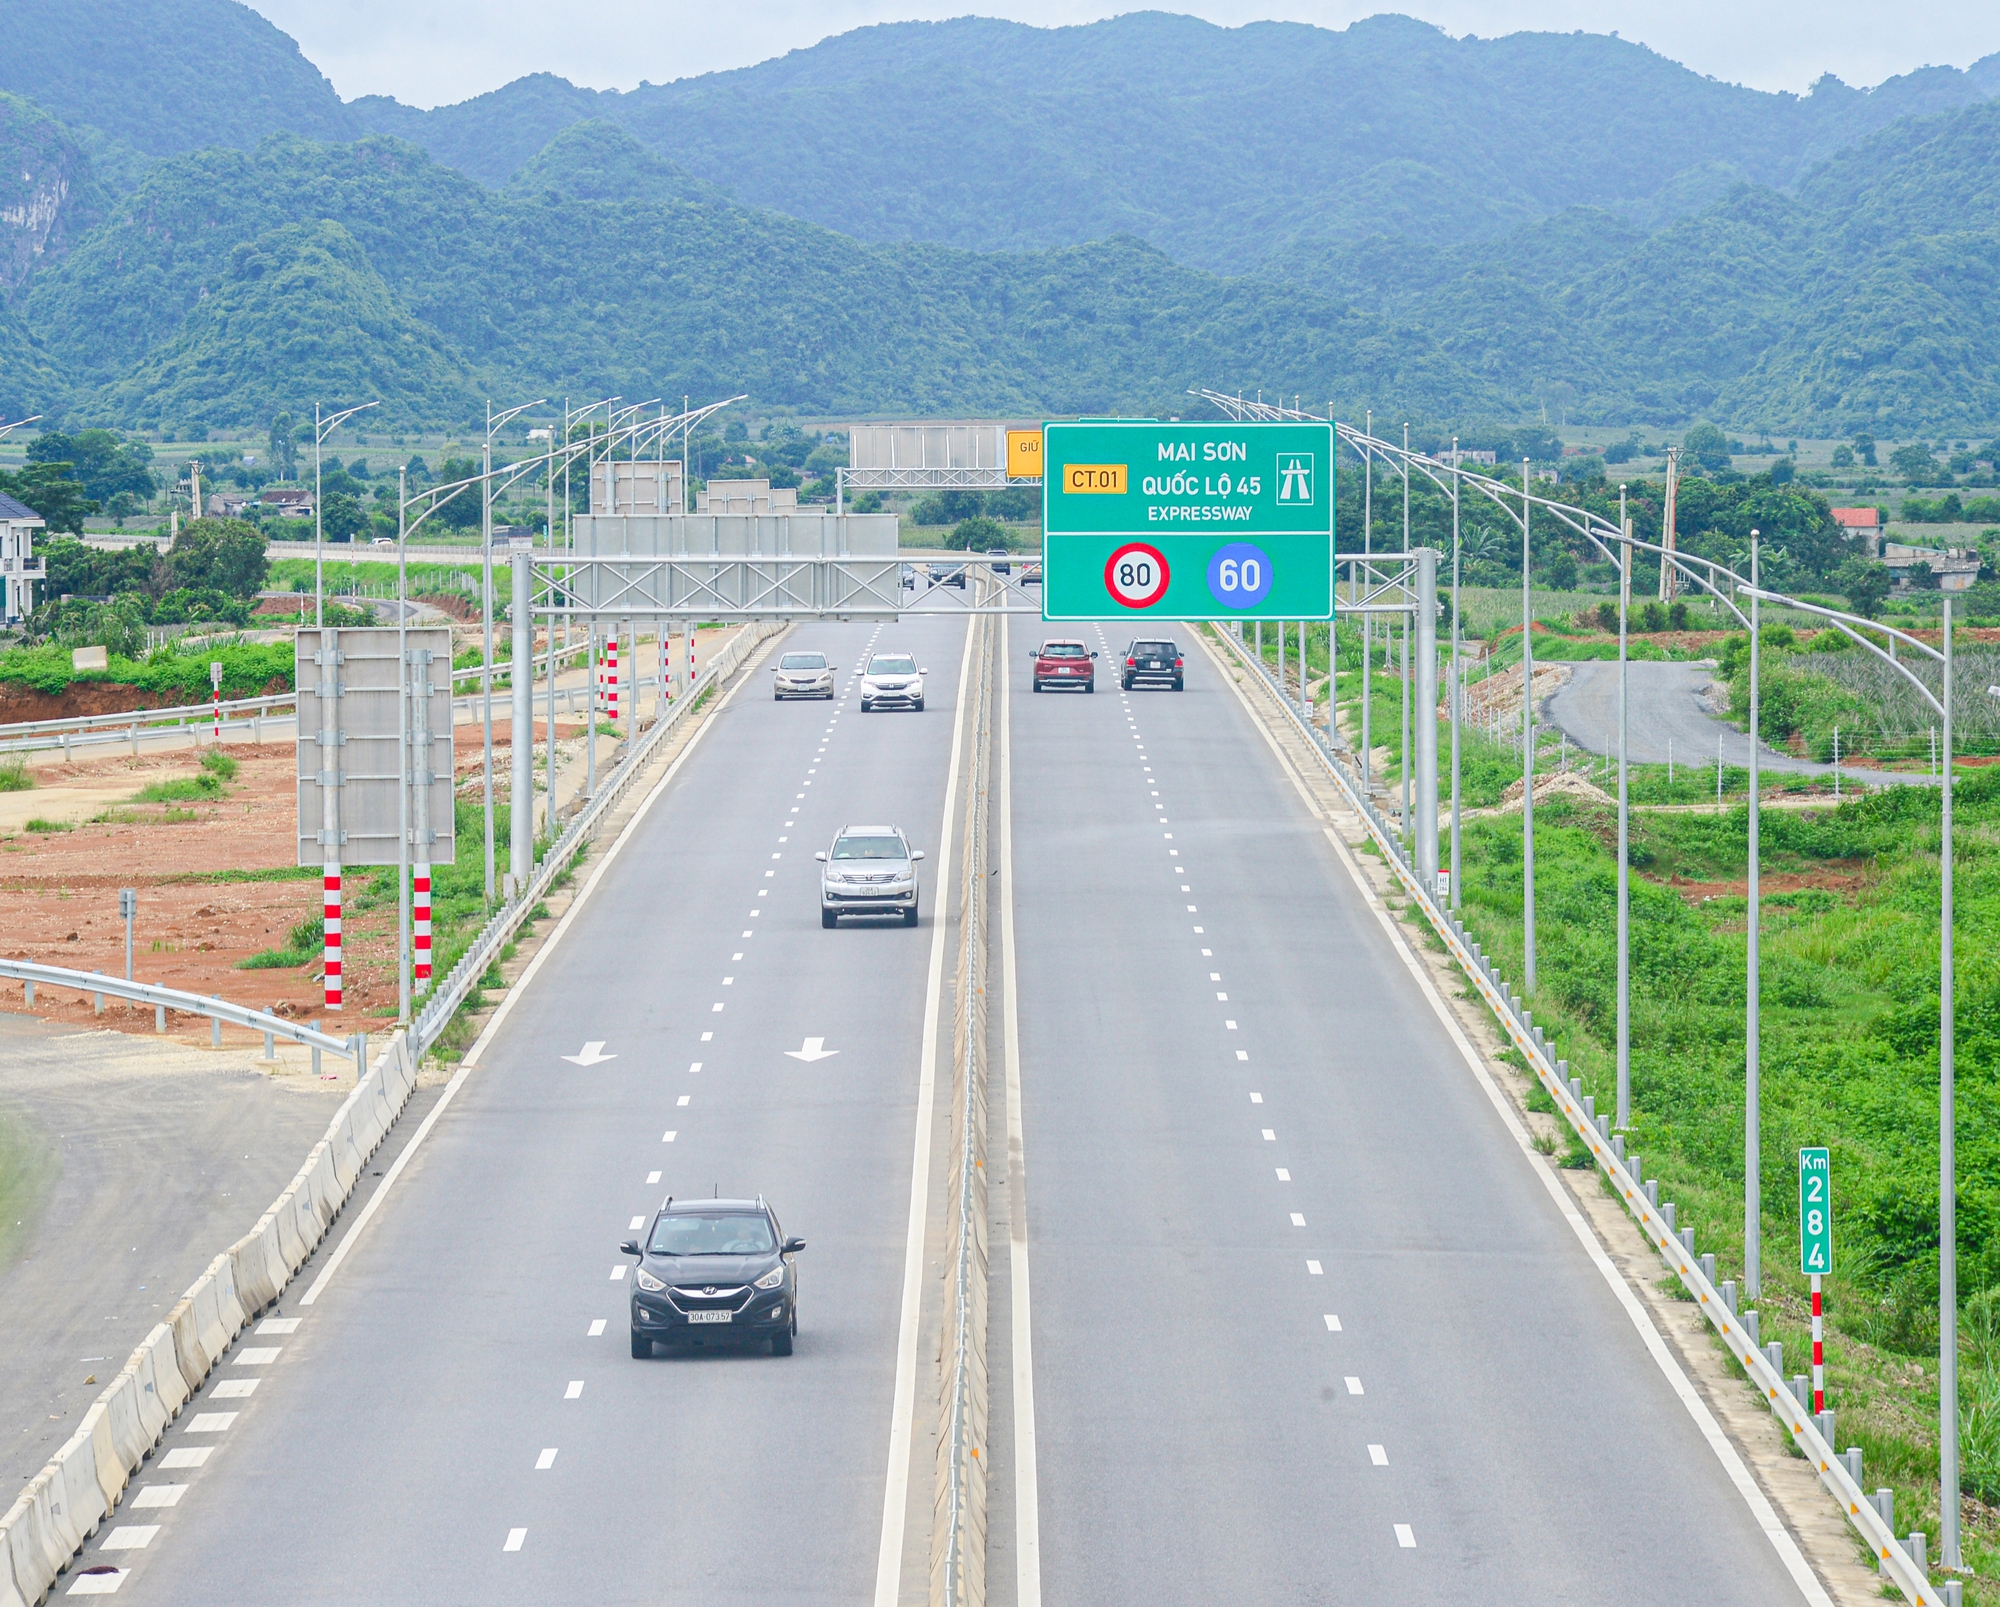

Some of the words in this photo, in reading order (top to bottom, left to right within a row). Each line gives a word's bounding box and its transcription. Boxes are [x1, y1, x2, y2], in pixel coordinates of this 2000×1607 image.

[1020, 439, 1040, 452] GIỮ
[1158, 442, 1196, 461] MAI
[1203, 440, 1247, 461] SƠN
[1072, 470, 1117, 488] CT.01
[1142, 469, 1199, 495] QUỐC
[1205, 472, 1232, 499] LỘ
[1236, 476, 1261, 495] 45
[1148, 506, 1253, 521] EXPRESSWAY
[1120, 563, 1151, 587] 80
[1219, 558, 1261, 592] 60
[1802, 1154, 1826, 1170] Km
[1807, 1176, 1825, 1269] 284
